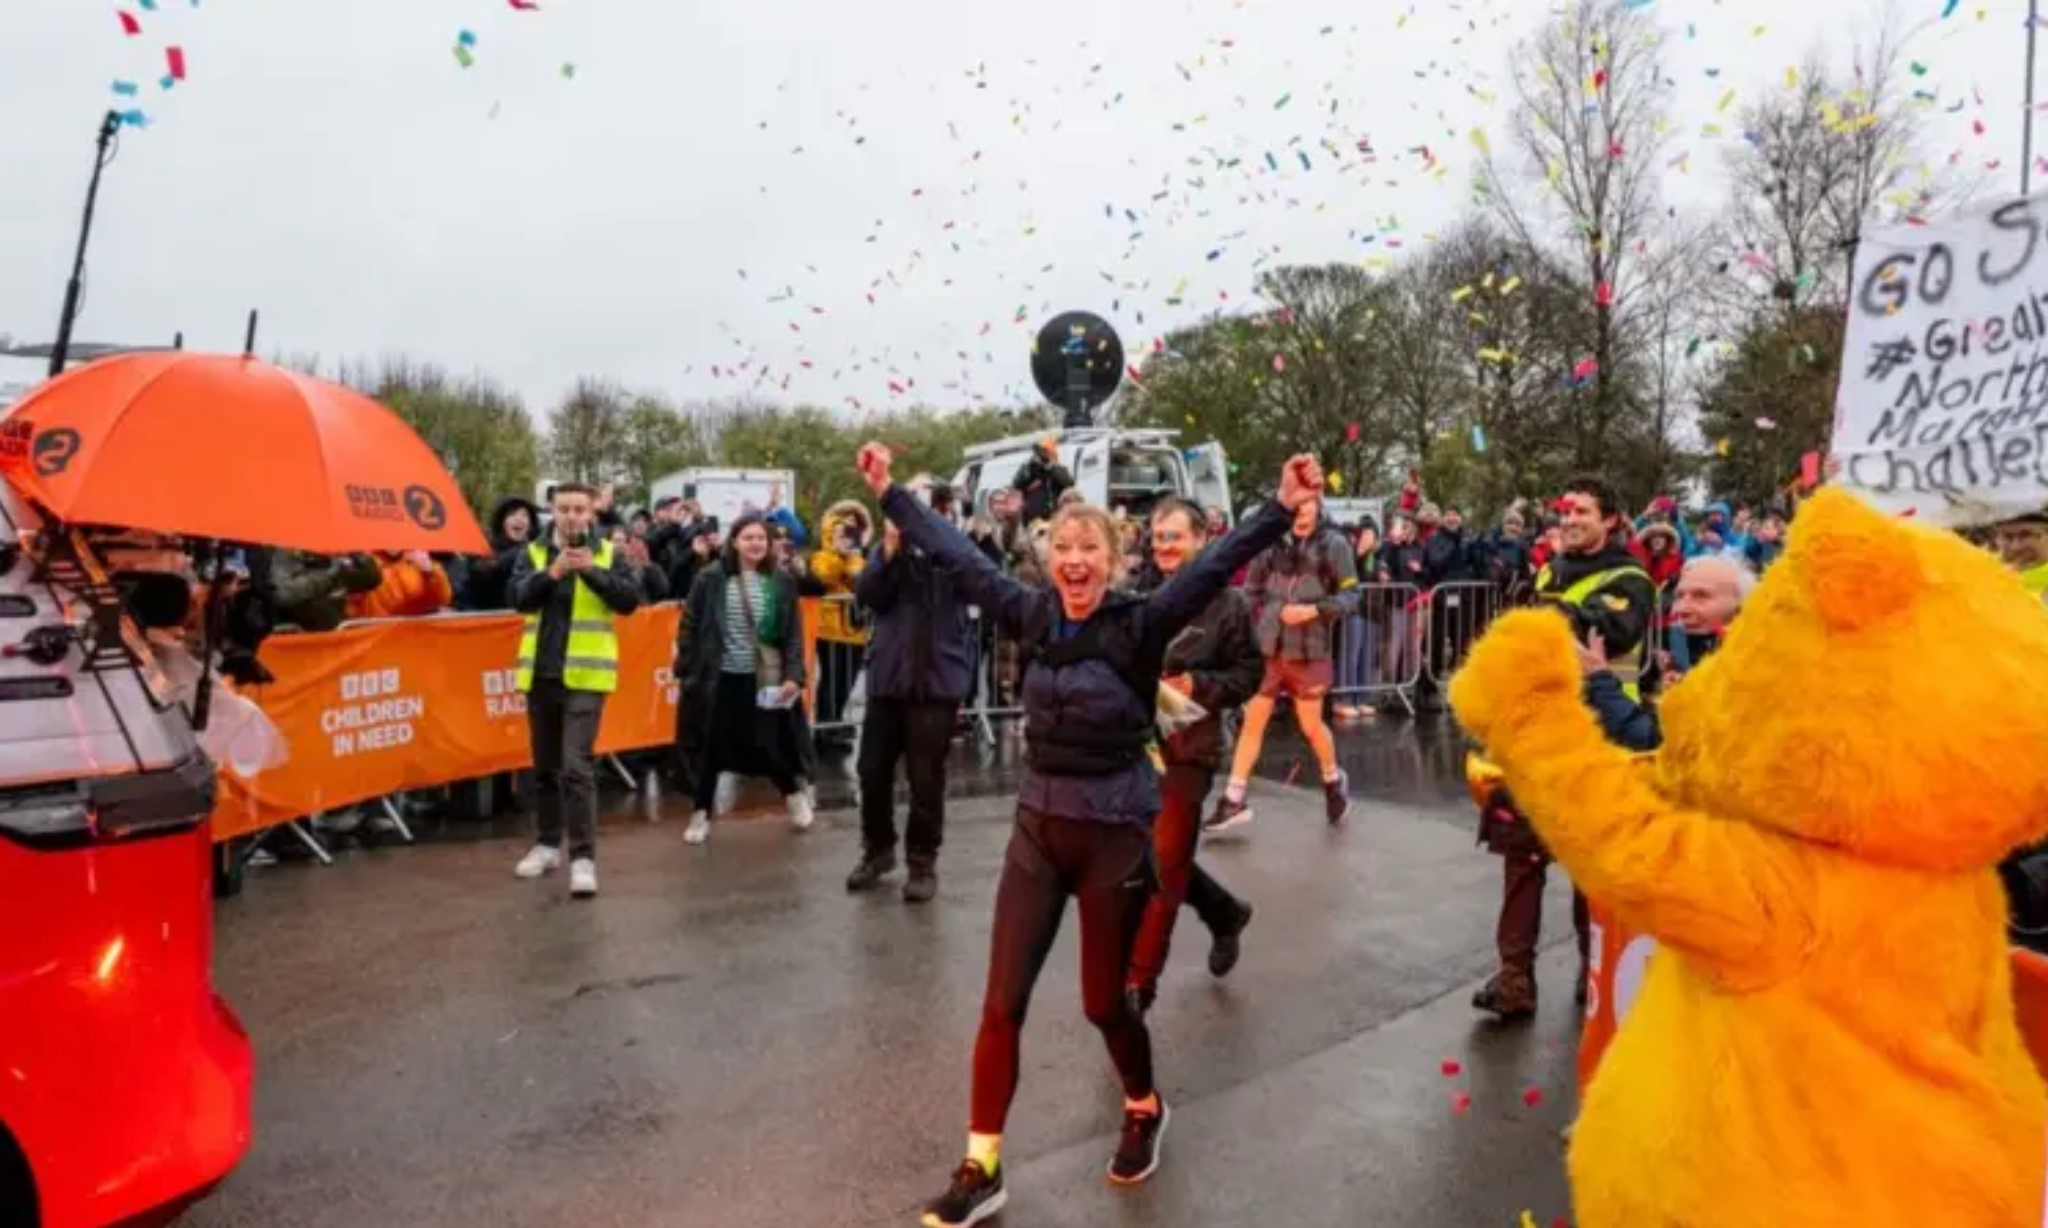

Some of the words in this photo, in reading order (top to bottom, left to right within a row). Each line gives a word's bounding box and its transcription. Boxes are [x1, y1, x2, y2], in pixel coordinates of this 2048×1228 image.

[1859, 242, 1953, 317] GO
[1976, 199, 2048, 286] S
[1894, 350, 2048, 410] North
[341, 666, 400, 701] BBC
[320, 695, 424, 735] CHILDREN
[483, 693, 528, 718] RAD
[332, 732, 354, 758] IN
[357, 722, 414, 752] NEED
